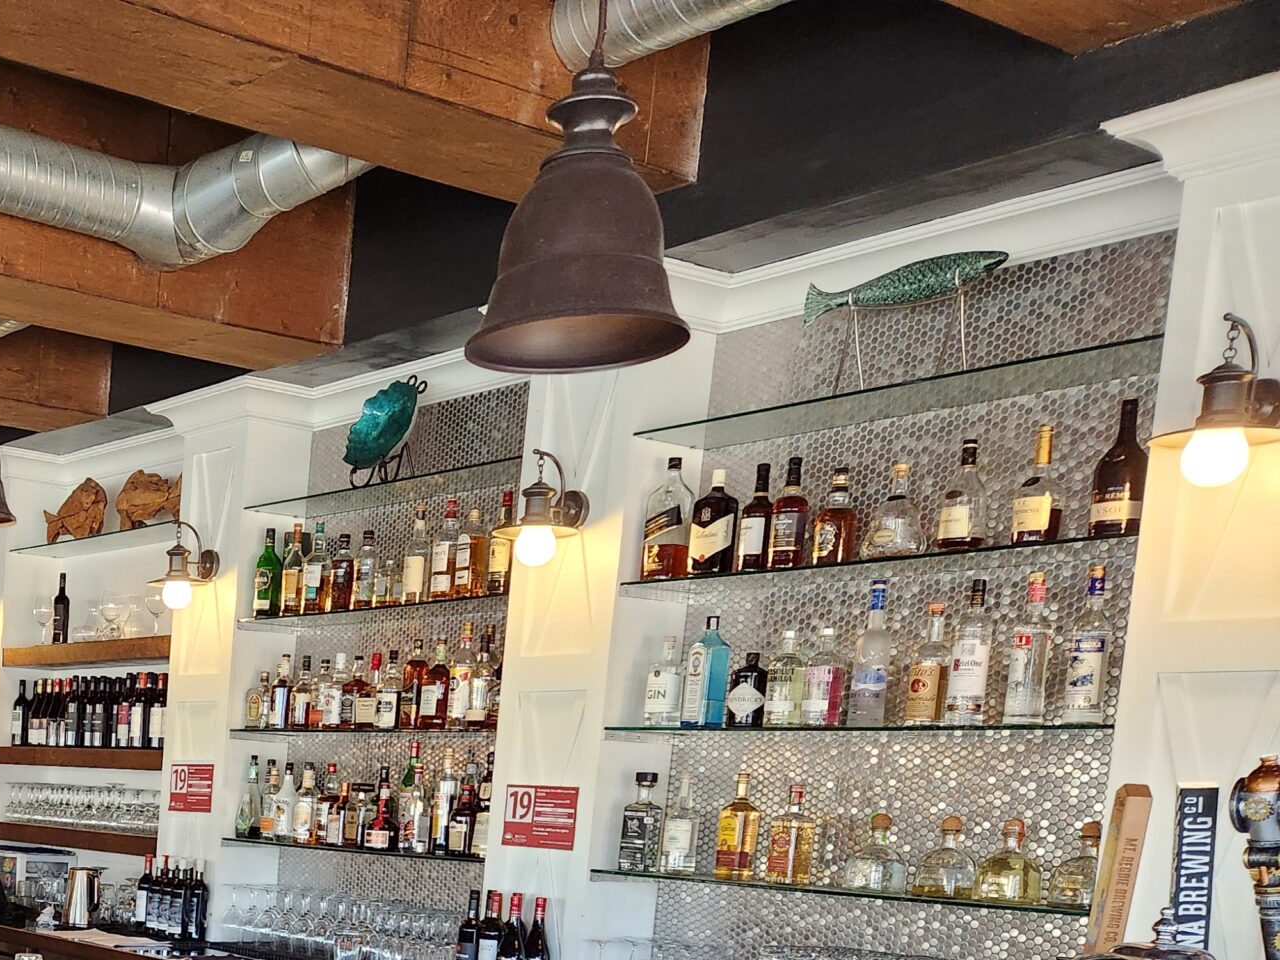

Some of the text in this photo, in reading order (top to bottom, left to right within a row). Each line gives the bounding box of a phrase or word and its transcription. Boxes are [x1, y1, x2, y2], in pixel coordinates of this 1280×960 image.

[647, 689, 667, 700] GIN
[172, 768, 187, 791] 19
[509, 790, 532, 820] 19
[1178, 816, 1213, 917] BREWING
[1106, 888, 1128, 929] BREWING
[1176, 919, 1206, 950] NA
